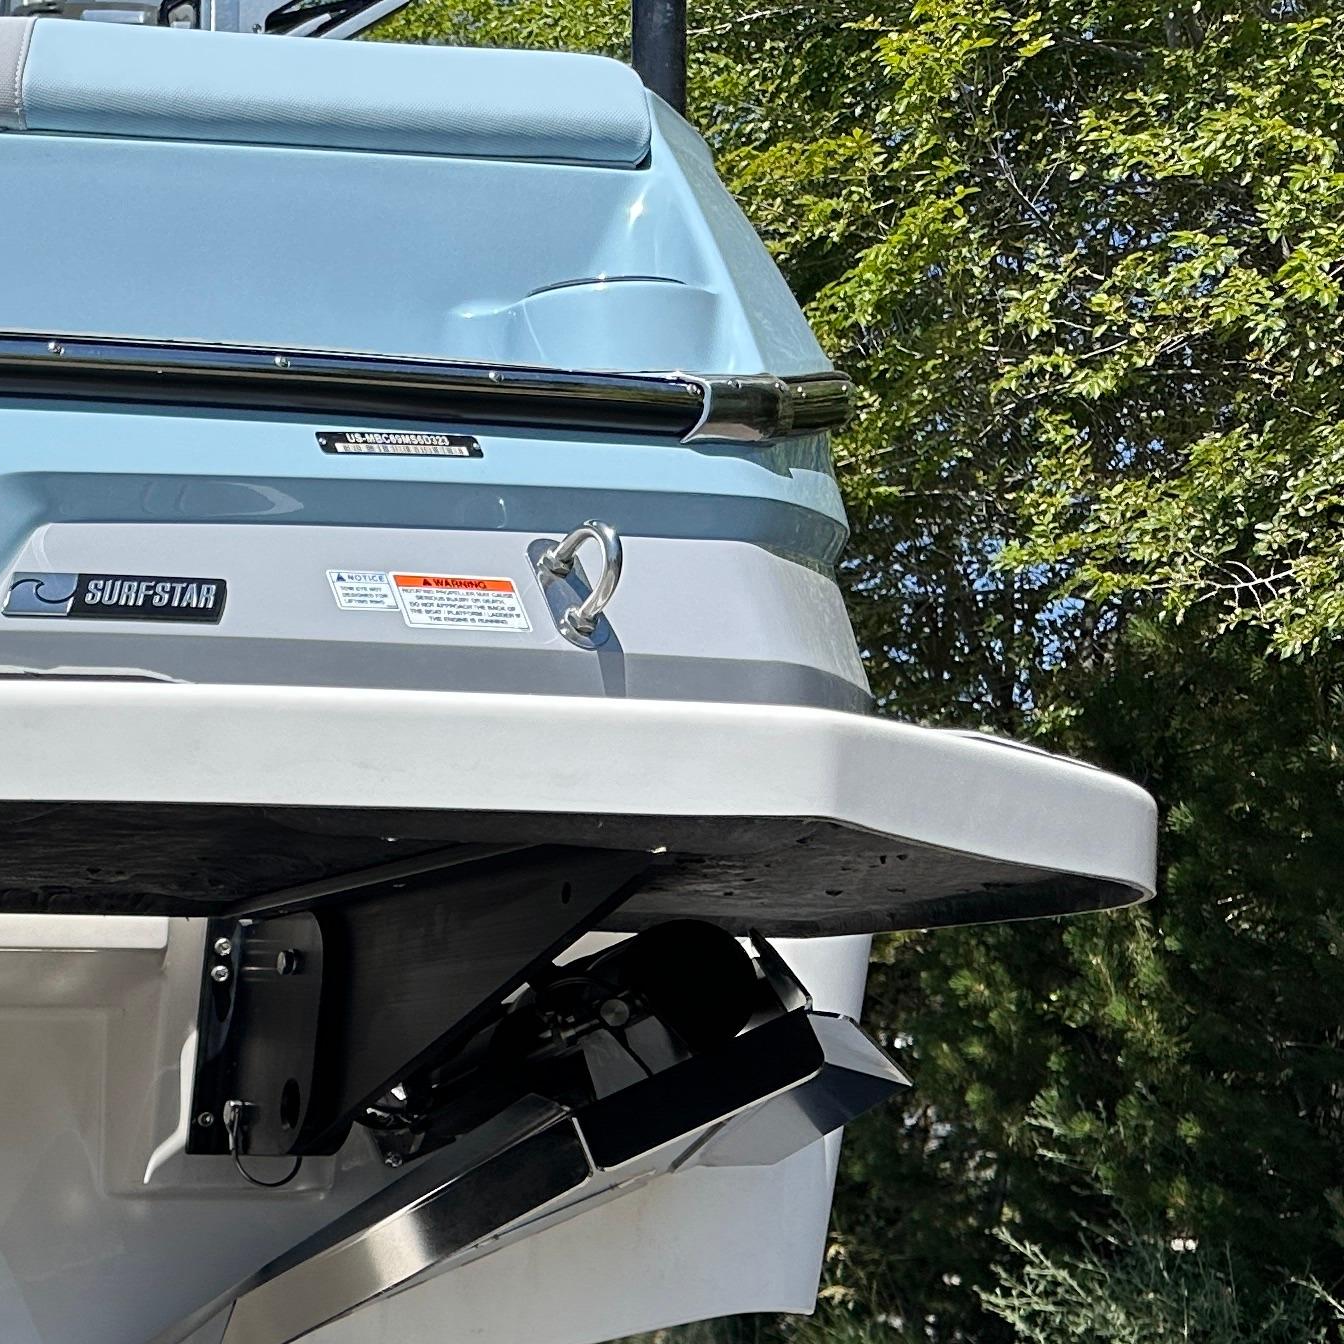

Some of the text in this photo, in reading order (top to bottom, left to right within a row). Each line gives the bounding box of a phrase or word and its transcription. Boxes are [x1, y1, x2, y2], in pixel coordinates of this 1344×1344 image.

[347, 574, 385, 582] NOTICE
[433, 578, 487, 589] WARNING
[84, 579, 216, 609] SURFSTAR
